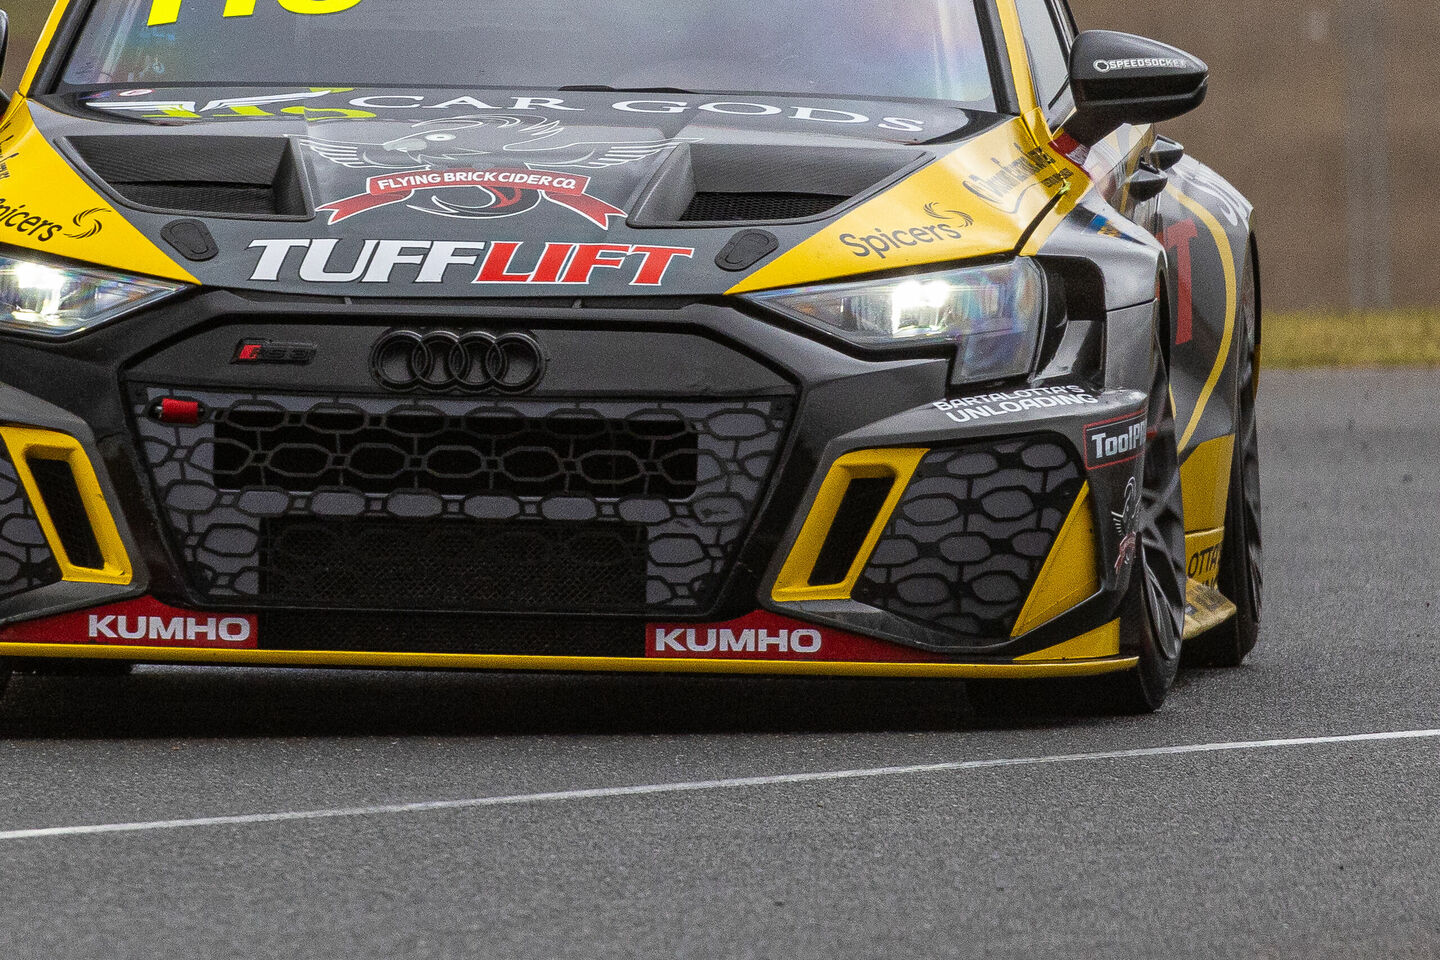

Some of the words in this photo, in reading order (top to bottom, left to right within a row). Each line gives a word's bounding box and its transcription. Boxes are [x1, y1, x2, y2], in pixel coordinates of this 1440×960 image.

[348, 95, 585, 111] CAR
[611, 100, 926, 132] GODS
[377, 172, 442, 191] FLYING
[444, 170, 497, 182] BRICK
[498, 171, 553, 186] CIDER
[839, 219, 963, 260] Spicers
[247, 238, 694, 287] TUFFLIFT
[932, 385, 1086, 411] BARTALOTTA'S
[946, 394, 1099, 423] UNLOADING
[88, 614, 251, 641] KUMHO
[655, 628, 823, 654] KUMHO
